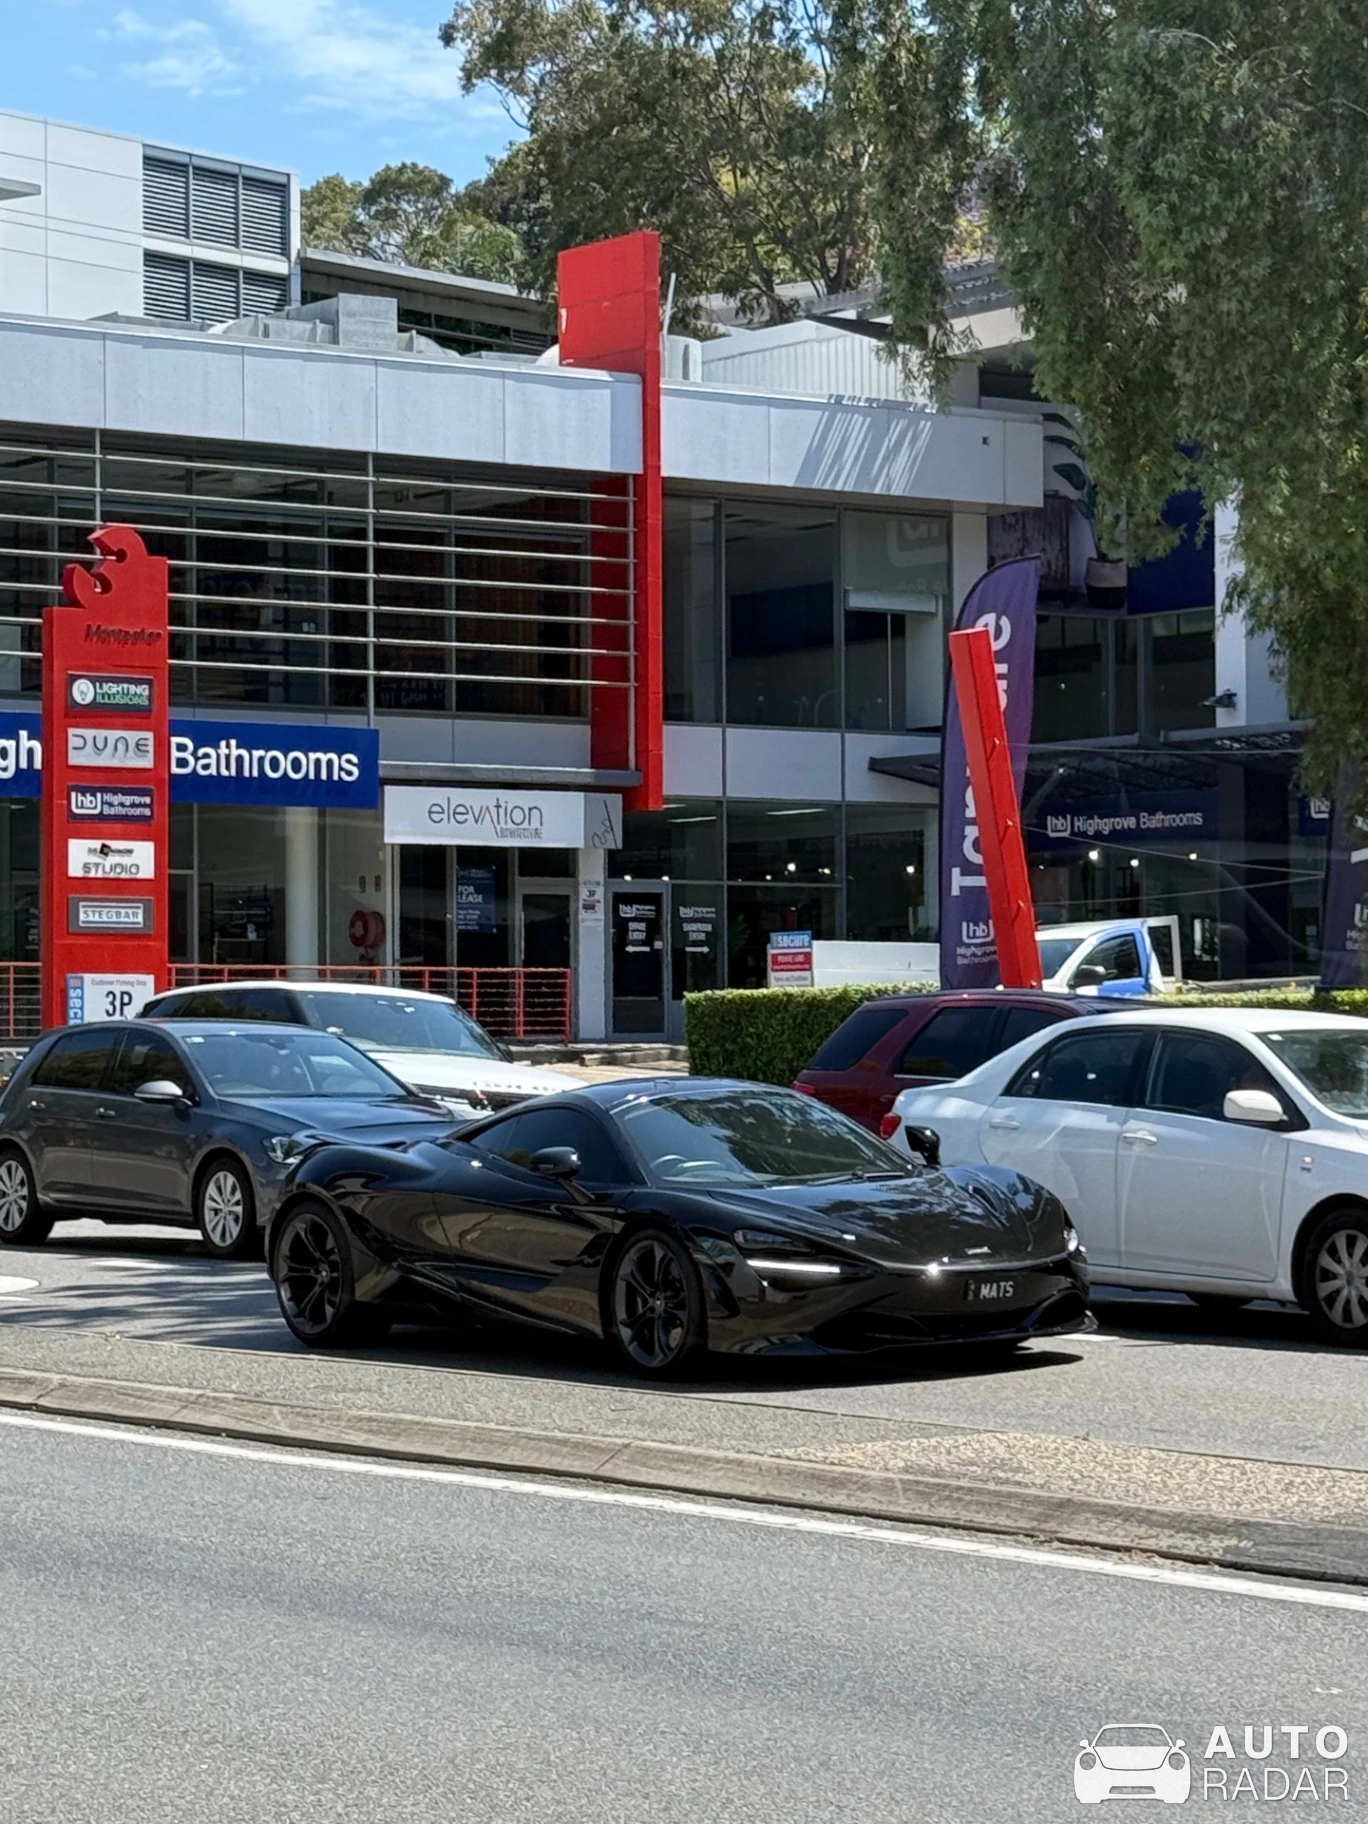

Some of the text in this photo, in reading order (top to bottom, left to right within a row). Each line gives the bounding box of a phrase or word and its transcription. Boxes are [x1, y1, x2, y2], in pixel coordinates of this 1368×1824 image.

[96, 682, 149, 695] LIGHTING
[96, 694, 149, 705] ILLUSIONS
[170, 737, 359, 781] Bathrooms
[103, 793, 151, 806] Highgrove
[103, 806, 151, 816] Bathrooms
[1074, 815, 1137, 835] Highgrove
[1140, 811, 1203, 828] Bathrooms
[82, 863, 140, 876] STUDIO
[82, 910, 140, 920] STEGBAR
[105, 990, 133, 1017] 3P
[979, 1281, 1014, 1300] MATS
